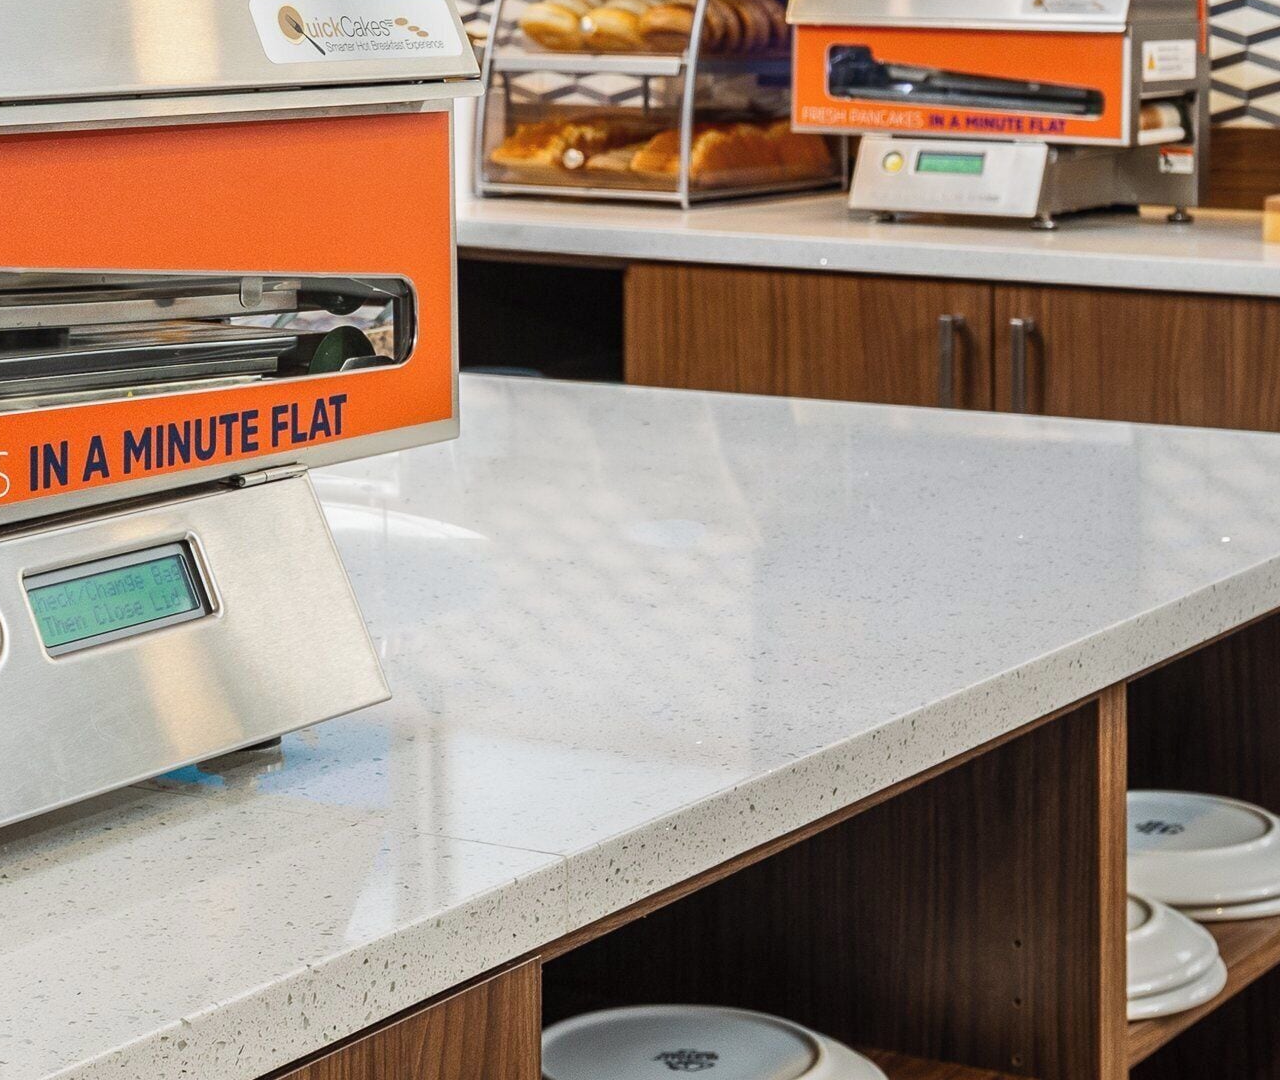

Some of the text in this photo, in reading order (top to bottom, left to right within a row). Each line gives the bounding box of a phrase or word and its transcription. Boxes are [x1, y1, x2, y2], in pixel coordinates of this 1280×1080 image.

[325, 39, 444, 53] Smarter Hot Breakfast Experience
[801, 106, 1066, 134] FRESH PANCAKES IN A MINUTE FLAT
[29, 443, 68, 492] IN
[83, 438, 111, 480] A
[123, 410, 260, 475] MINUTE
[270, 393, 348, 446] FLAT
[44, 590, 181, 638] Then Close Lid
